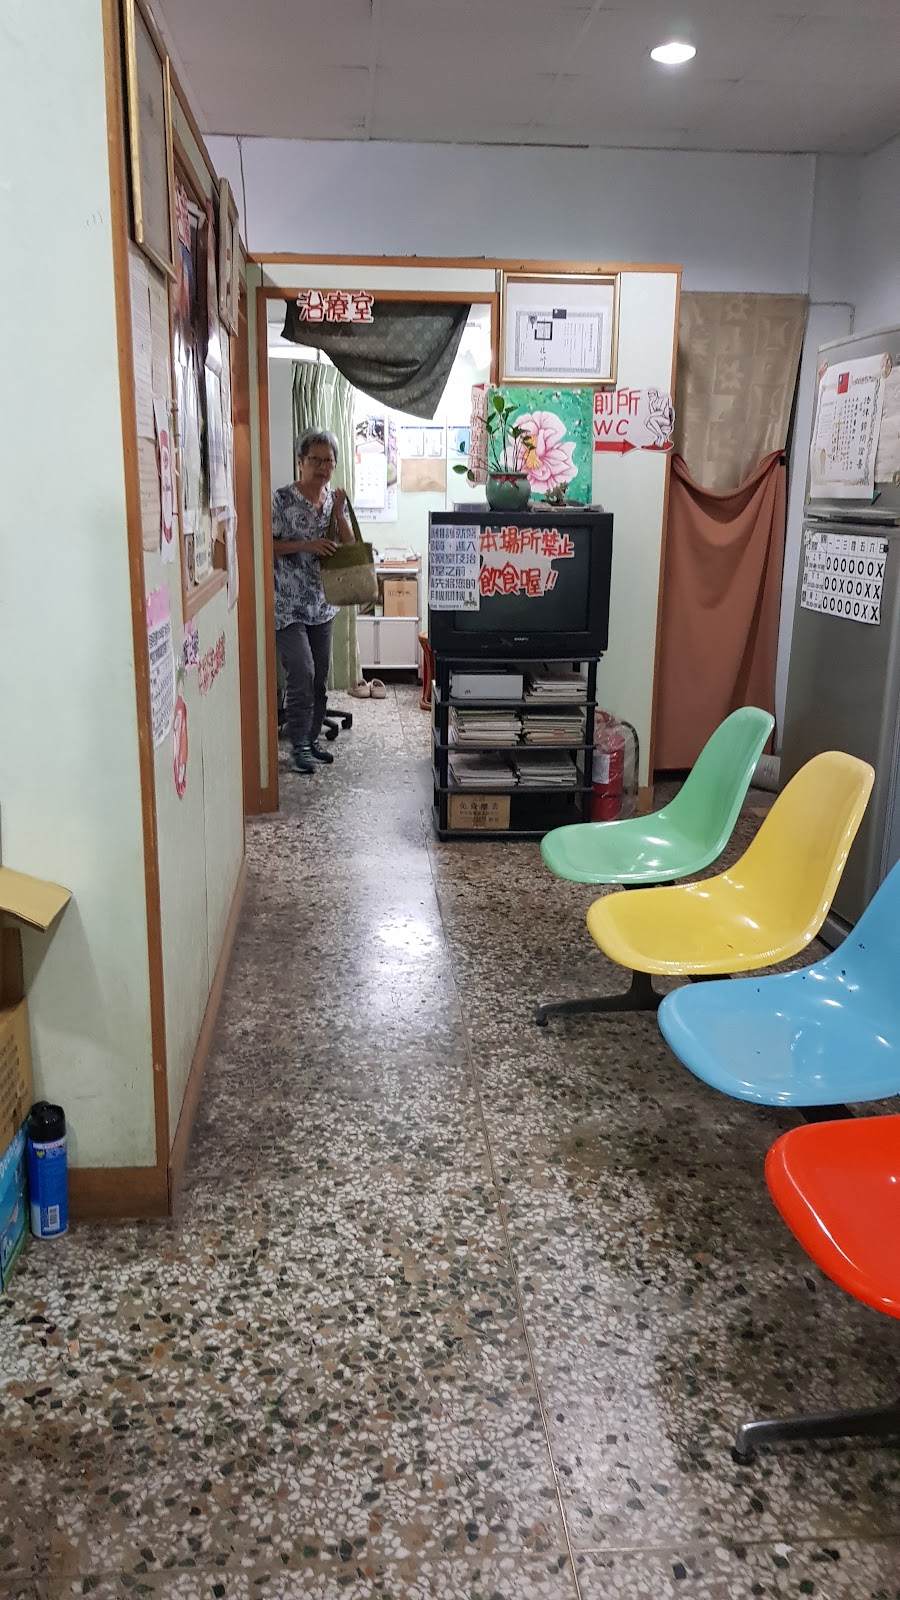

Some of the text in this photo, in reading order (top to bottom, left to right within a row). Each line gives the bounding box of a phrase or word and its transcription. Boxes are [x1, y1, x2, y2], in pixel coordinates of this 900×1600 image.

[297, 289, 373, 321] 治療室
[593, 419, 629, 436] WC
[479, 526, 573, 556] 本場所禁止
